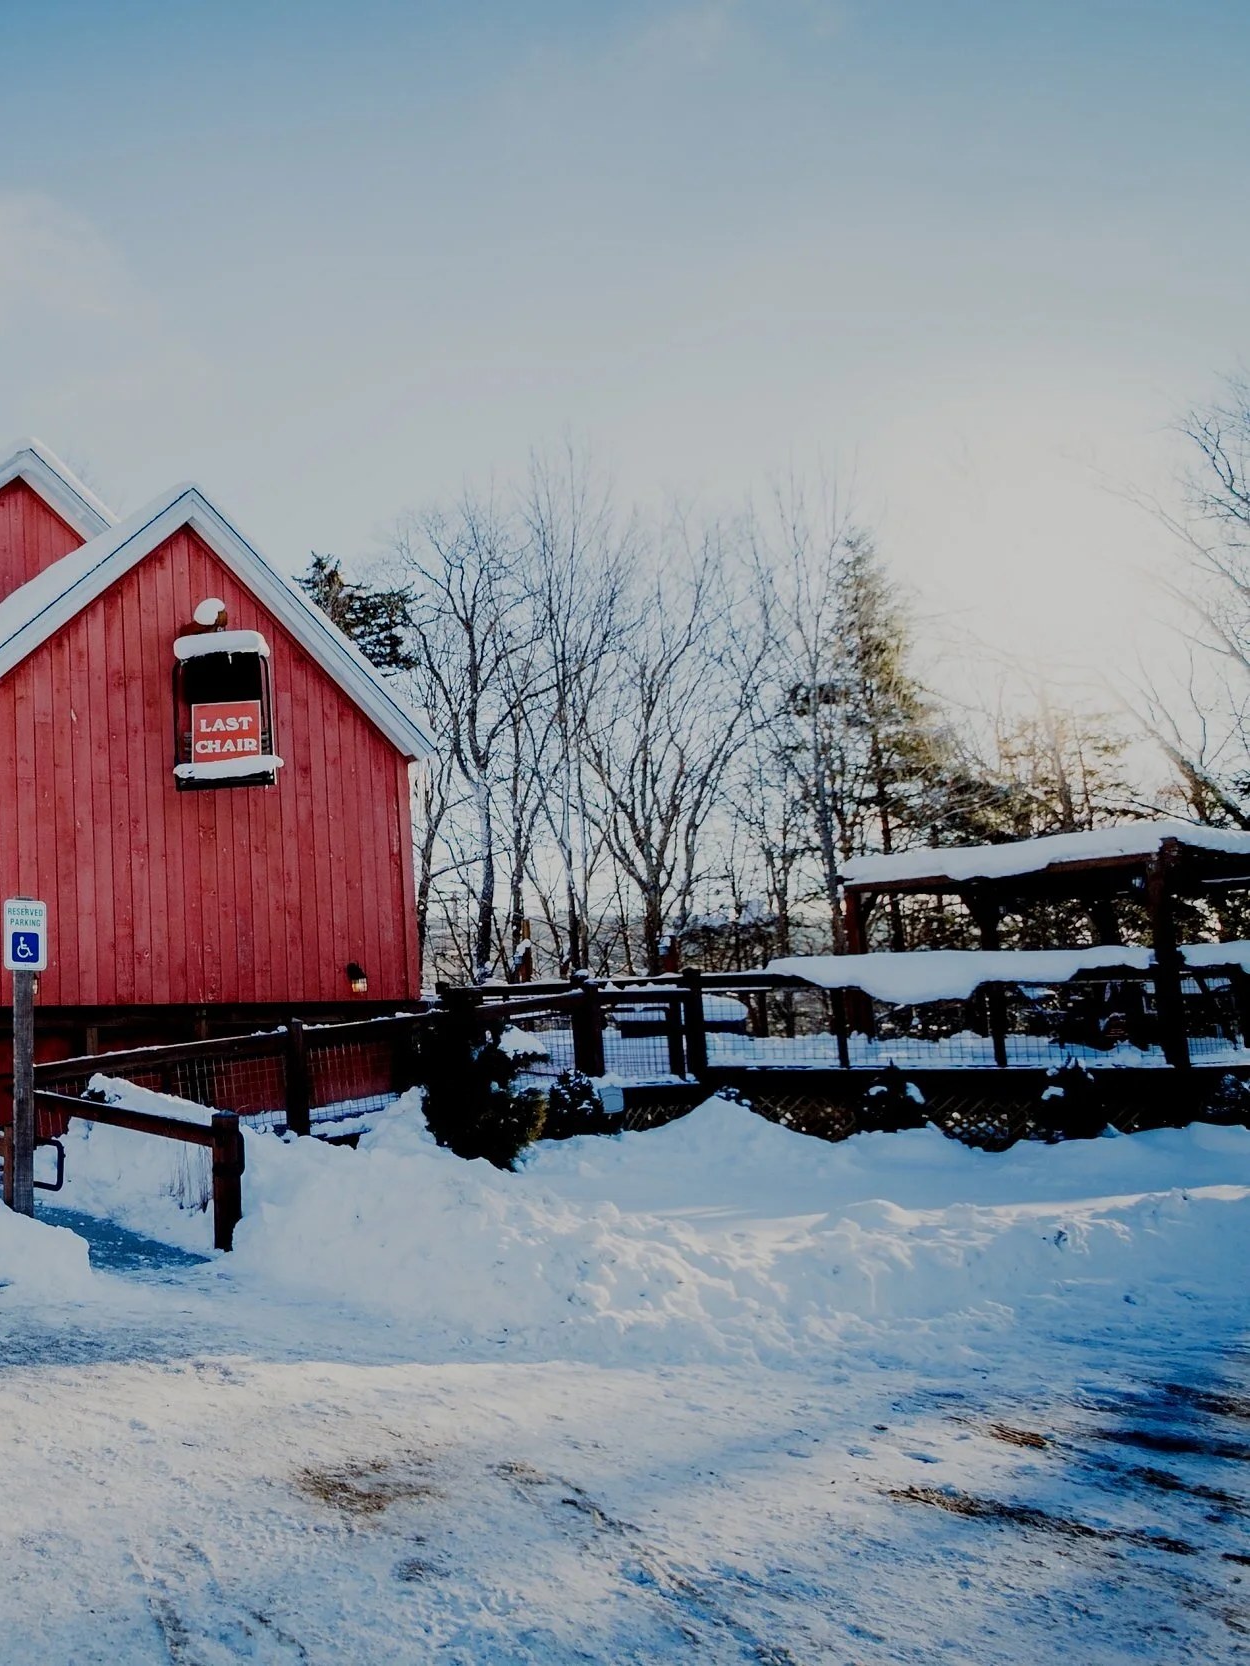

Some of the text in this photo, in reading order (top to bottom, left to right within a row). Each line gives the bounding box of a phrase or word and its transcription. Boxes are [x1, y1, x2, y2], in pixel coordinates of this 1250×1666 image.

[200, 717, 253, 732] LAST
[195, 738, 258, 753] CHAIR
[7, 907, 43, 916] RESERVED
[10, 918, 41, 927] PARKING
